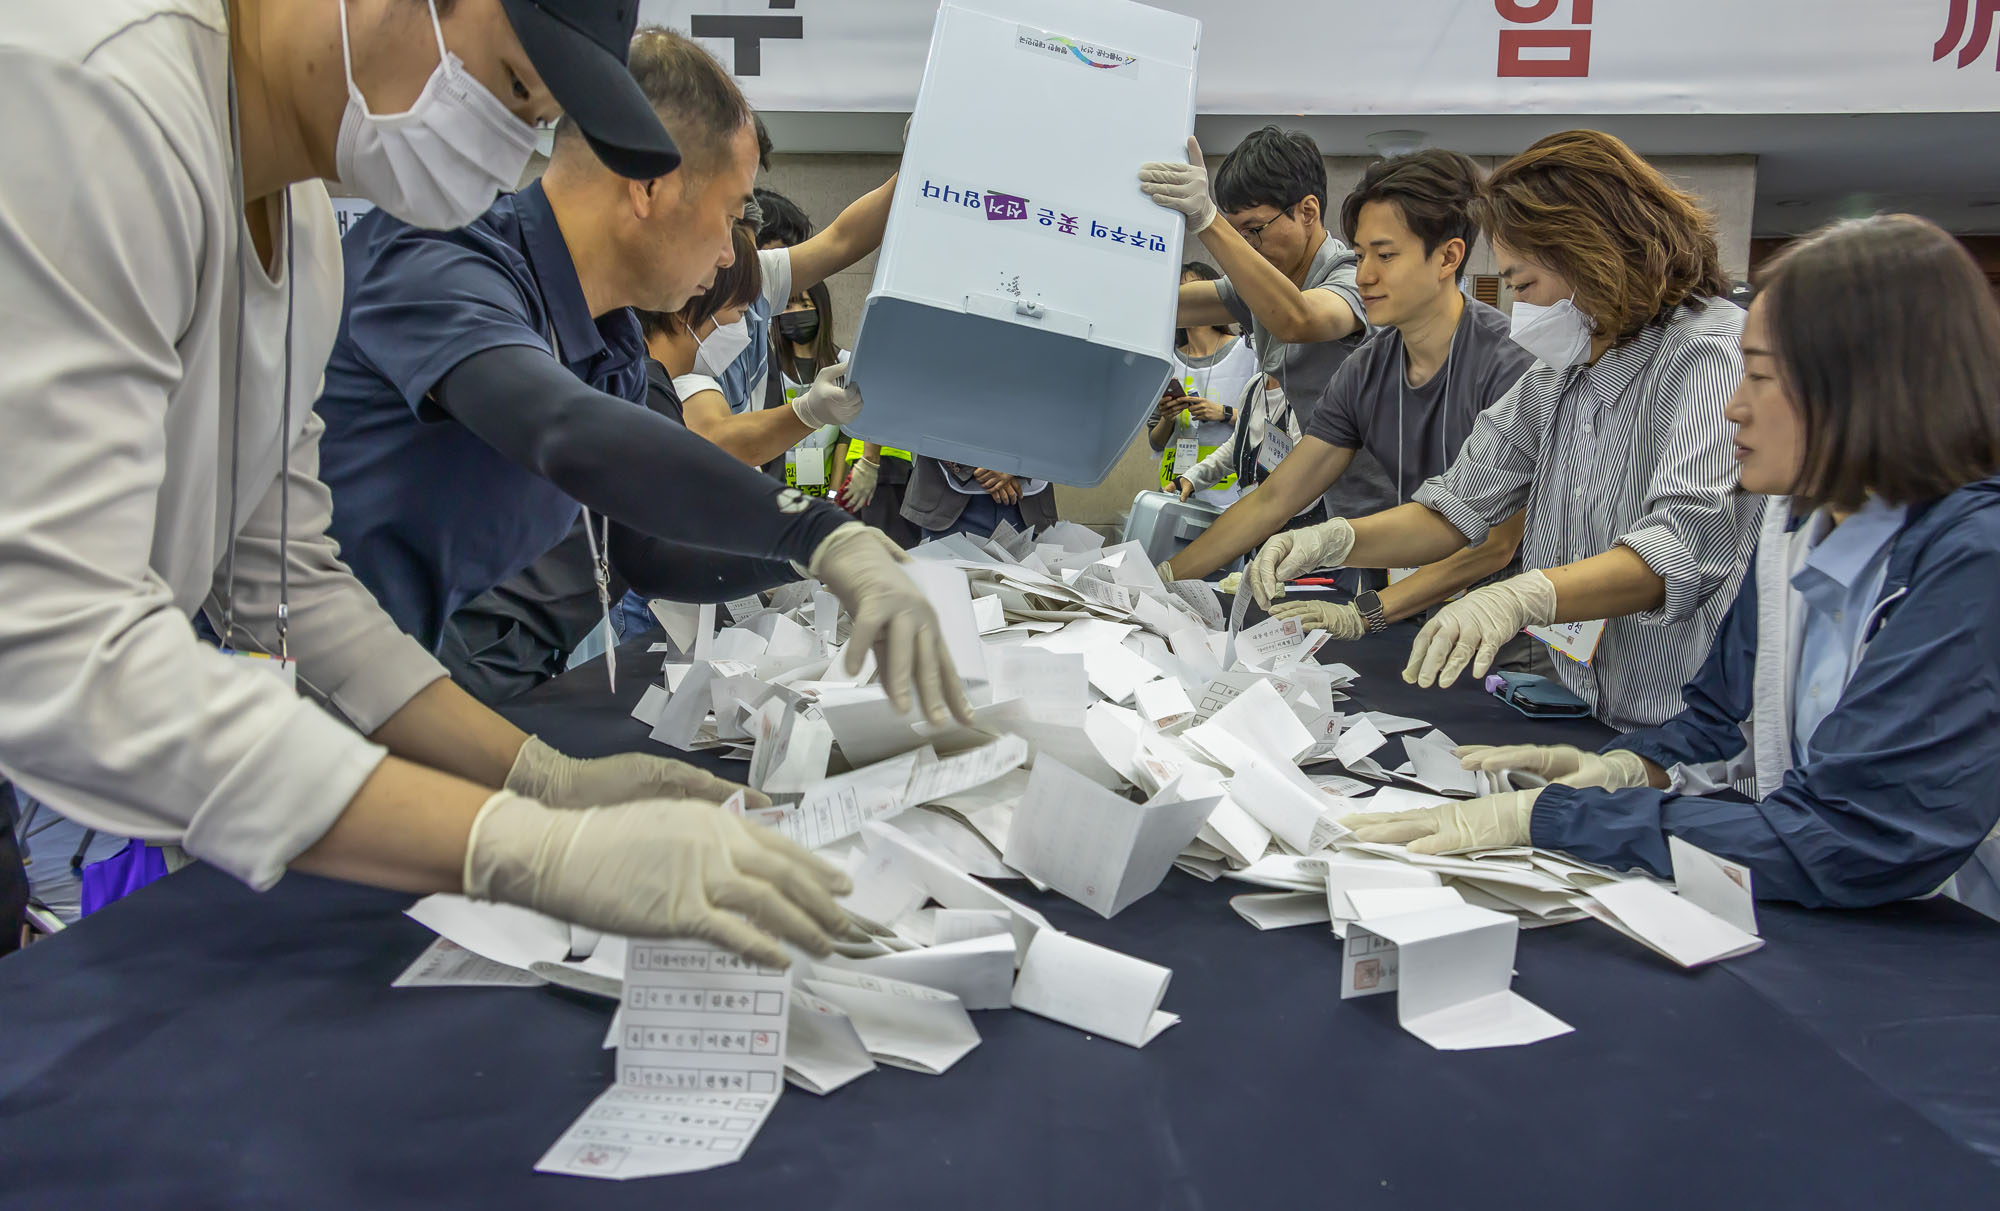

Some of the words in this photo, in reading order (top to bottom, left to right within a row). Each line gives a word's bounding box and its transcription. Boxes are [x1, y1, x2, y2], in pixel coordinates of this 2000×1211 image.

[1018, 35, 1046, 50] 대한민국
[1047, 43, 1068, 56] 행복한
[1080, 44, 1094, 55] 선거
[1096, 48, 1123, 63] 아름다운
[1037, 208, 1079, 236] 꽃은
[1090, 220, 1167, 253] 민주주의
